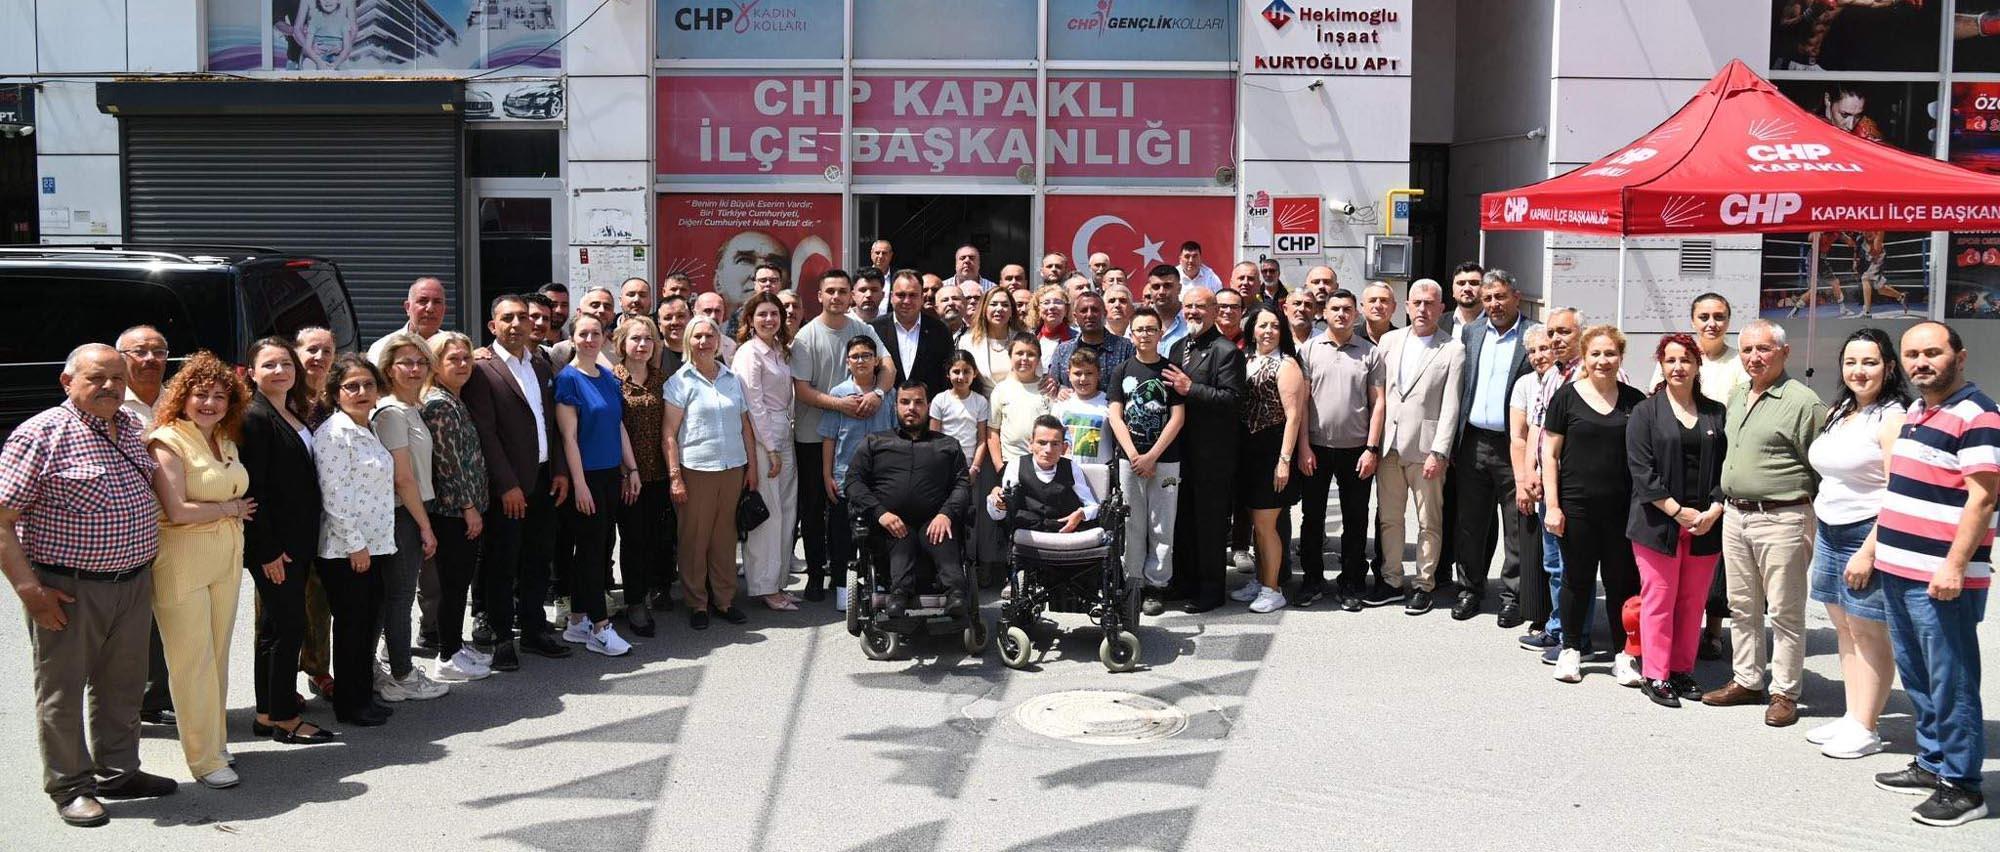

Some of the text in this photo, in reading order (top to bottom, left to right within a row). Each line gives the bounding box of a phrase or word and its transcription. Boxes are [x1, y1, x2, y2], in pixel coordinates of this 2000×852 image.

[675, 7, 733, 31] CHP
[753, 8, 797, 18] KADIN
[753, 20, 807, 31] KOLLARI
[1067, 18, 1099, 30] CHP
[1316, 24, 1379, 46] İnşaat
[1255, 53, 1357, 70] KURTOĞLU
[754, 79, 1135, 117] CHP KAPAKLI
[1975, 93, 2000, 110] ÖZ
[700, 117, 1192, 172] İLÇE BAŞKANLIĞI
[1747, 143, 1832, 162] CHP
[1747, 163, 1864, 173] KAPAKLI
[757, 200, 785, 208] Eserim
[1396, 202, 1407, 212] 20
[1504, 196, 1529, 223] CHP
[1529, 208, 1553, 220] KAPAKLI
[1554, 206, 1568, 224] İLÇE
[1720, 192, 2000, 225] CHP KAPAKLI İLÇE BAŞKAN
[718, 209, 747, 218] Türkiye
[704, 218, 751, 228] Cumhuriyet
[752, 219, 771, 227] Halk
[1277, 236, 1316, 251] CHP
